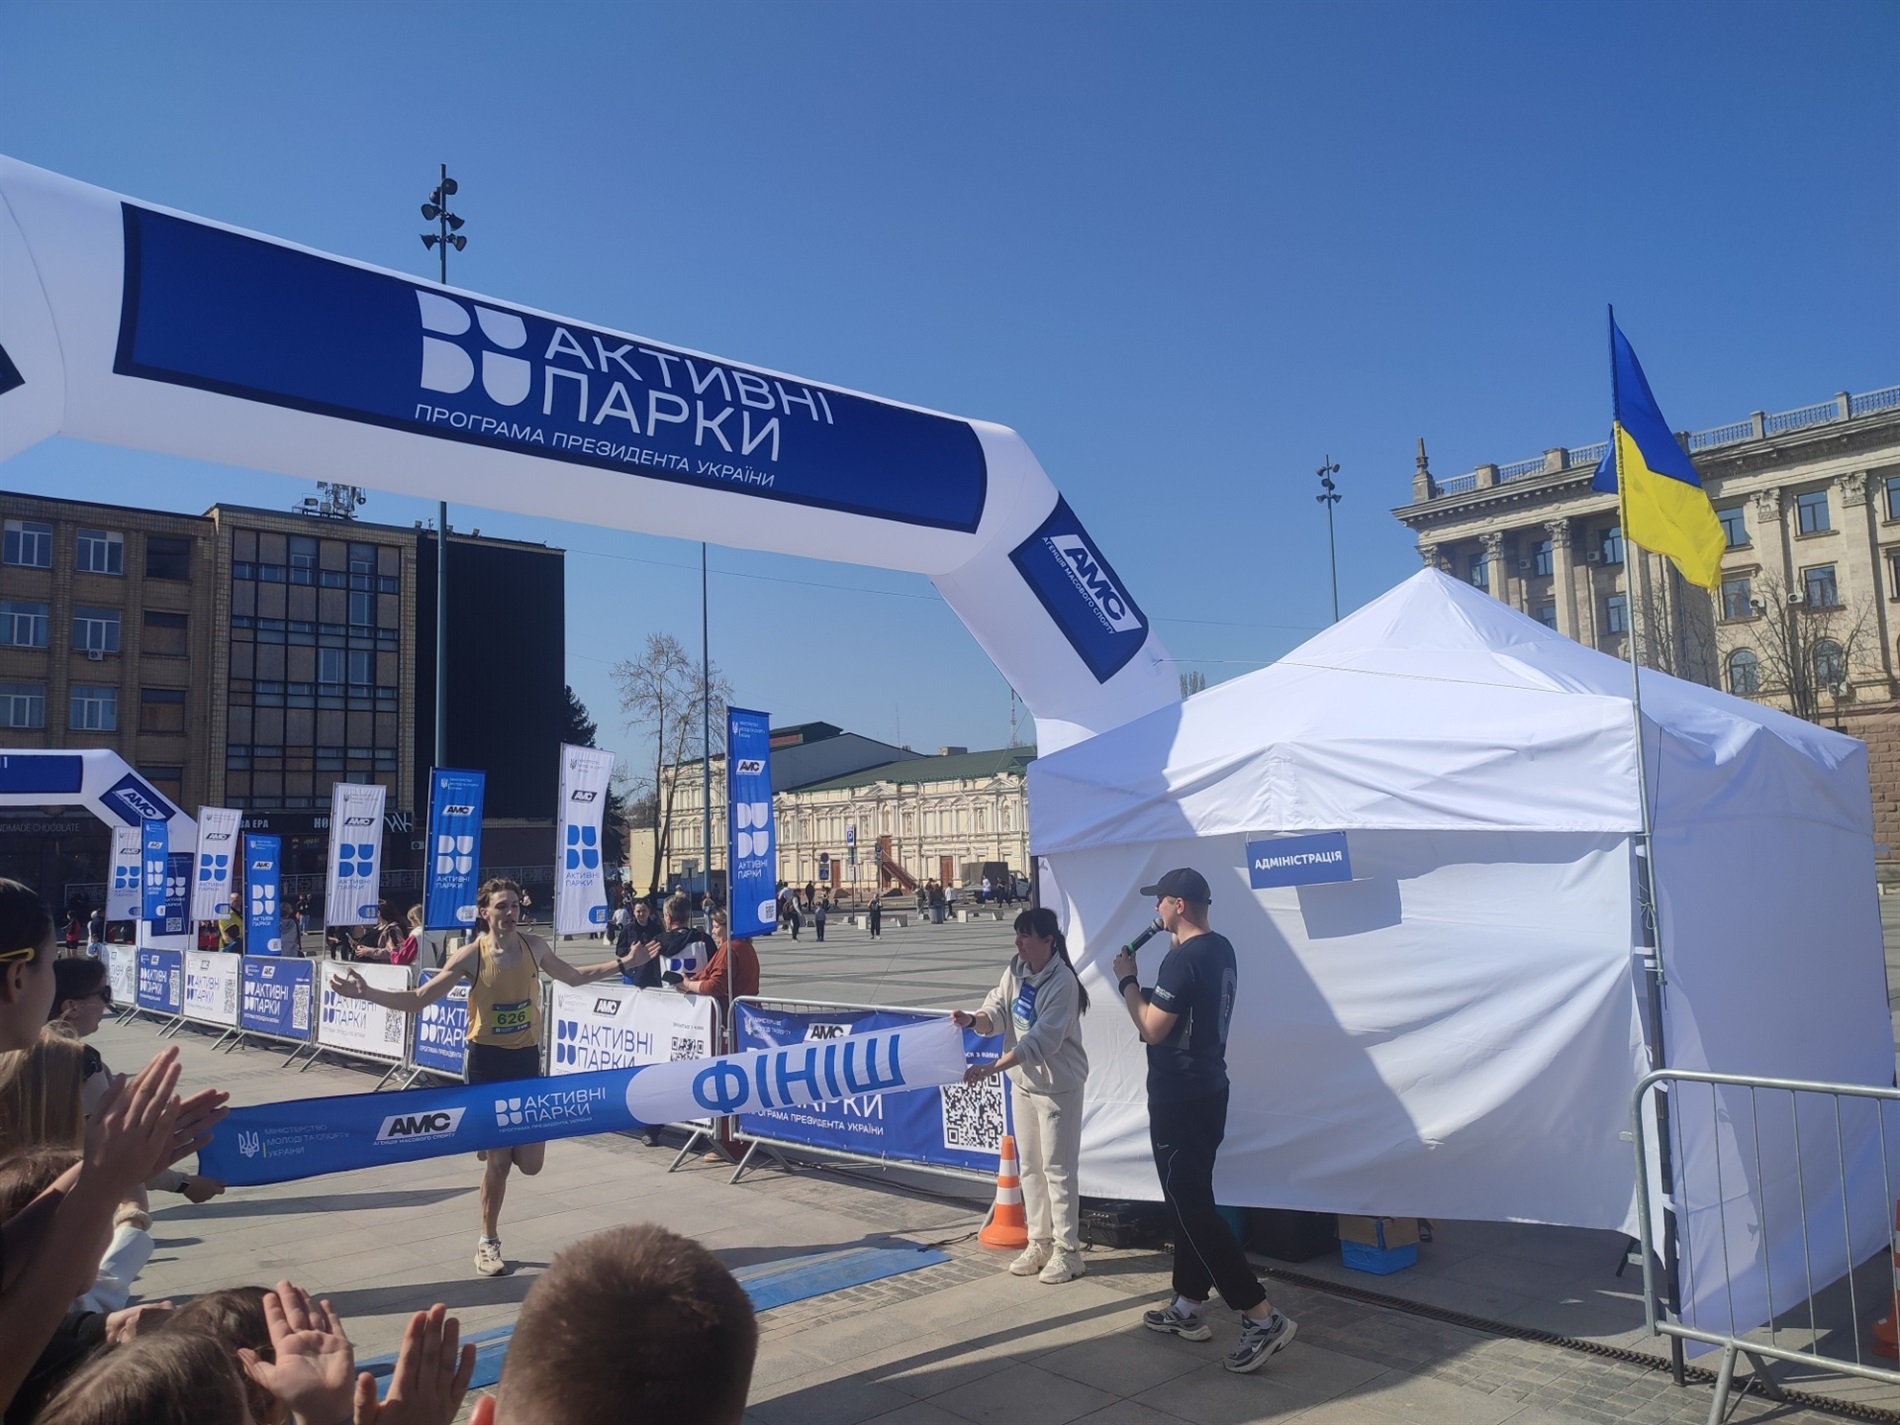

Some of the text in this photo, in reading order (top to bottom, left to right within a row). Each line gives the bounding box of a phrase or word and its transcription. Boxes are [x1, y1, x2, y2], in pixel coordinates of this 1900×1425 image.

[545, 327, 834, 424] АКТИВНІ
[543, 365, 780, 462] ПАРКИ
[415, 404, 775, 487] ПРОГРАМА ПРЕЗИДЕНТА УКРАЇНИ
[1042, 537, 1115, 634] АГЕНЦІЯ МАСОВОГО СПОРТУ
[33, 823, 80, 832] CHOCOLATE
[1255, 850, 1343, 870] АДМІНІСТРАЦІЯ
[255, 982, 289, 1000] АКТИВНІ
[255, 999, 280, 1016] ПАРКИ
[438, 1005, 469, 1028] АКТИ
[497, 1011, 525, 1025] 626
[335, 1010, 367, 1028] ПАРКИ
[437, 1026, 469, 1048] ПАРК
[579, 1023, 653, 1055] АКТИВНІ
[577, 1047, 635, 1070] ПАРКИ
[692, 1034, 907, 1113] ФІНІШ
[524, 1087, 606, 1109] АКТИВНІ
[524, 1103, 591, 1123] ПАРКИ
[790, 1113, 845, 1129] ПРЕЗИДЕНТА
[847, 1121, 884, 1135] УКРАЇНИ
[264, 1124, 328, 1135] МІНІСТЕРСТВО
[267, 1135, 302, 1146] МОЛОДІ
